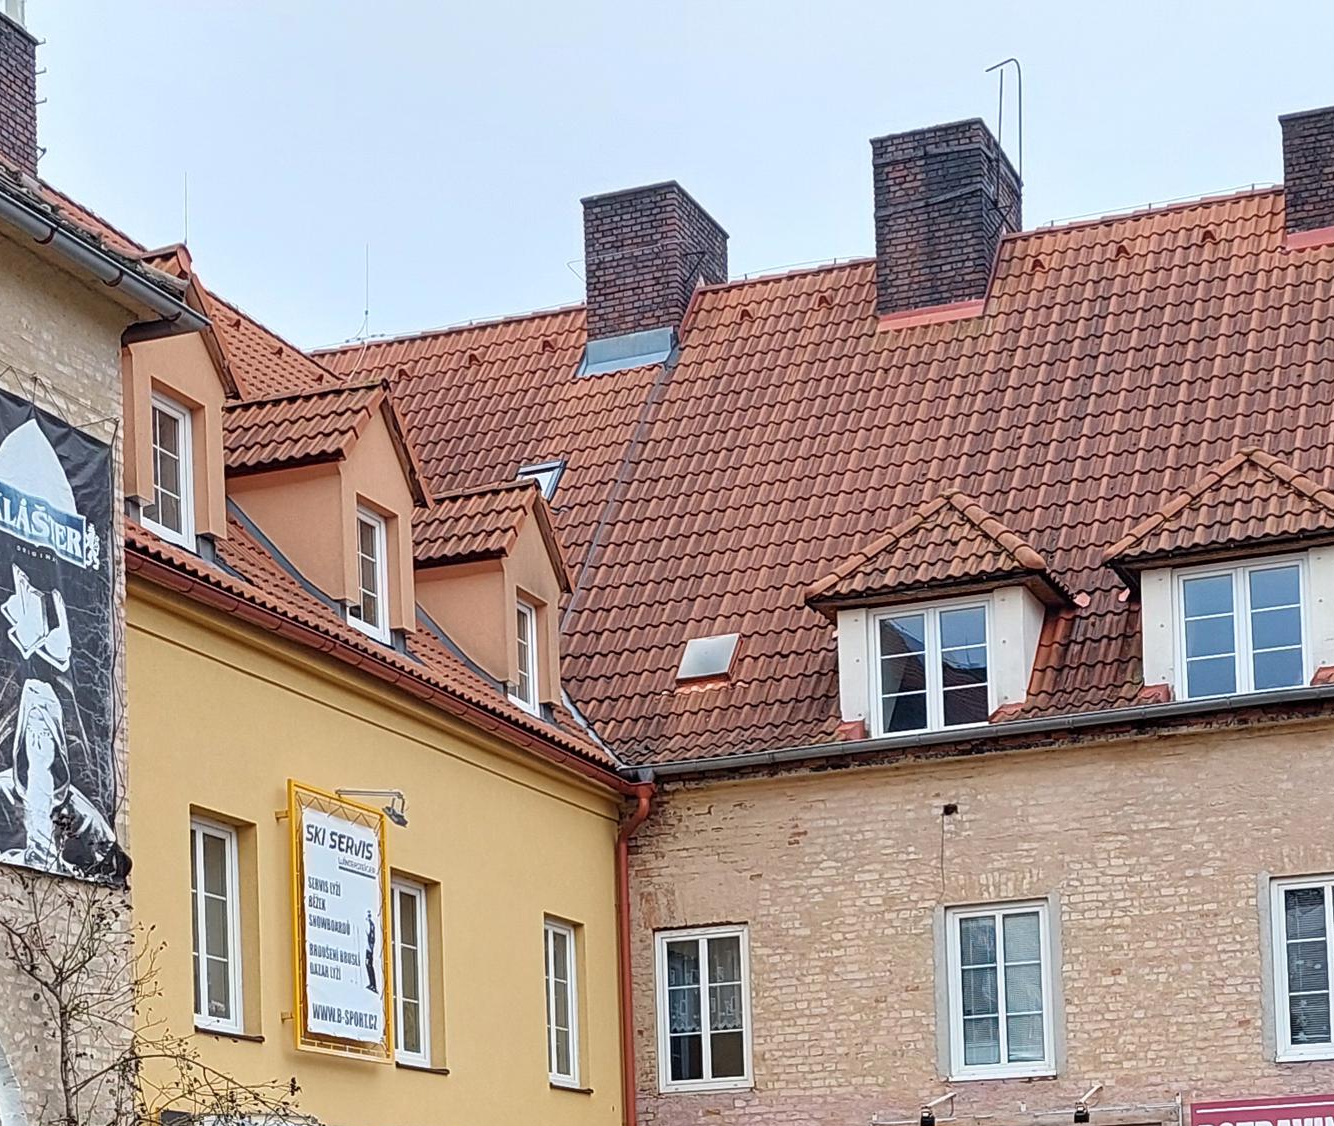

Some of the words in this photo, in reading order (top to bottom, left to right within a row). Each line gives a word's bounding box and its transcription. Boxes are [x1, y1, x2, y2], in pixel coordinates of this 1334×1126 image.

[305, 823, 327, 846] SKI
[328, 831, 374, 861] SERVIS
[308, 876, 329, 895] SERVIS
[312, 1002, 378, 1030] WWW.B-SPORT.CZ
